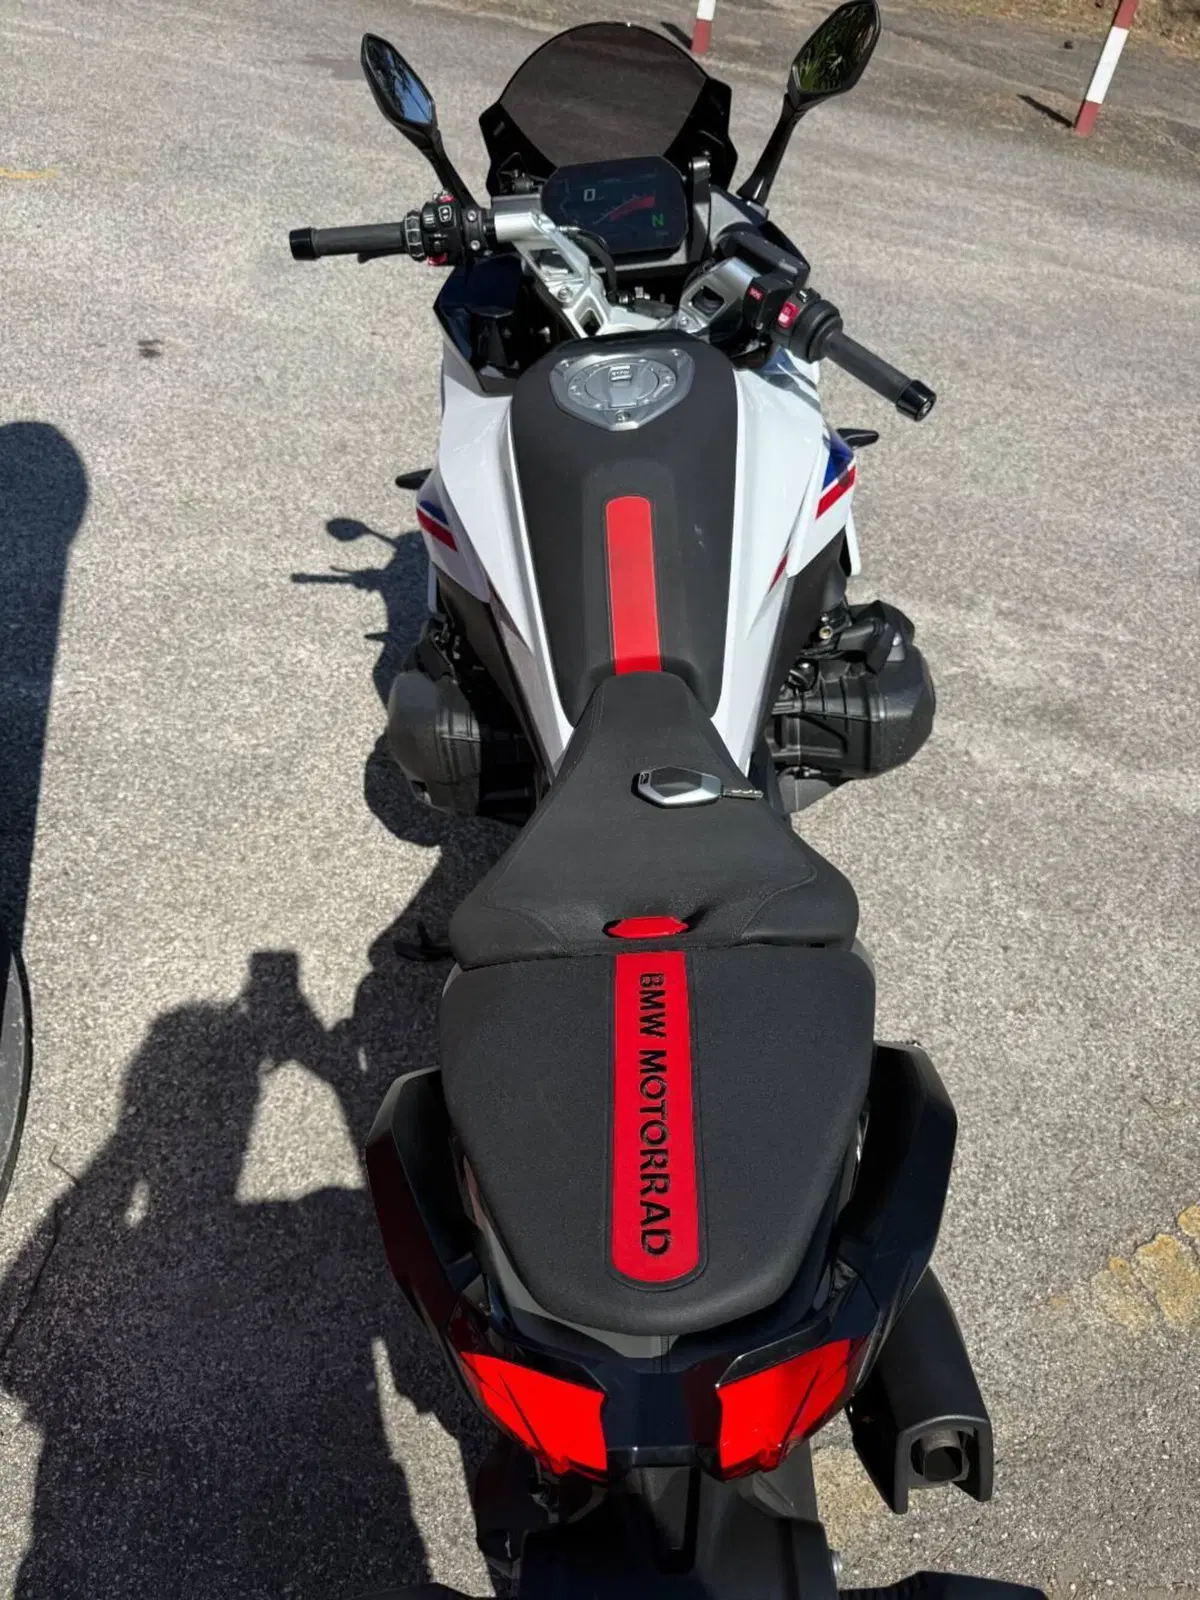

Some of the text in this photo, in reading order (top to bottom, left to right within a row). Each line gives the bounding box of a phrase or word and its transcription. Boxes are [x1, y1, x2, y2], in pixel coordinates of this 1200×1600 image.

[584, 188, 596, 201] 0
[652, 213, 664, 227] N
[639, 972, 672, 1257] BMW MOTORRAD
